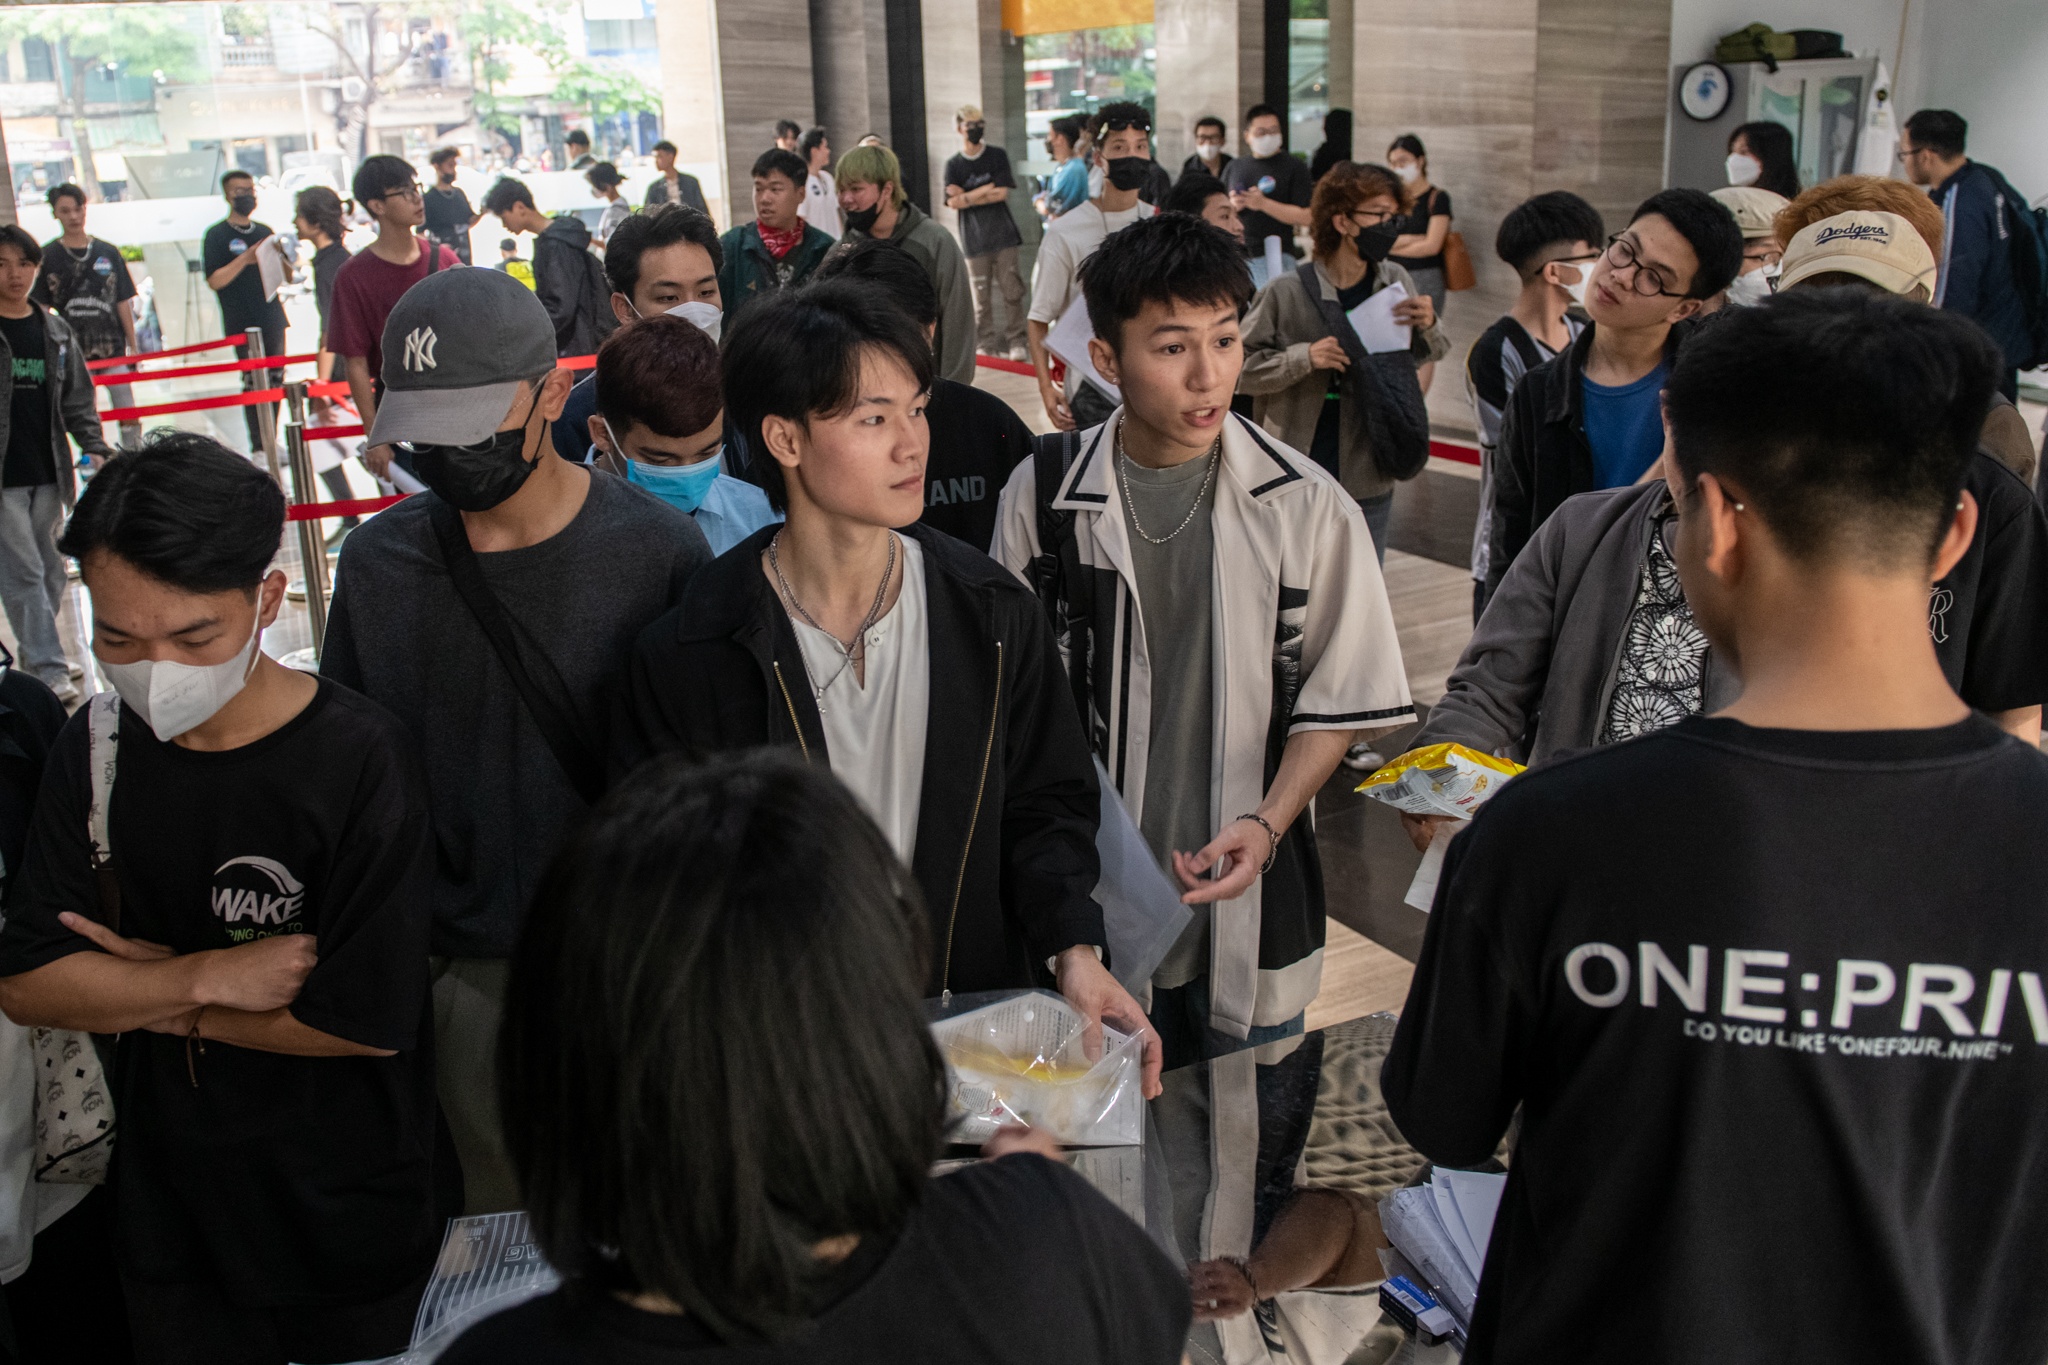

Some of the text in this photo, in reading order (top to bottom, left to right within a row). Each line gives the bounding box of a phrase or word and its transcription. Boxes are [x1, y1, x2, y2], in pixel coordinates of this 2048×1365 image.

[1814, 222, 1888, 246] Dodgers
[402, 325, 438, 372] NY
[924, 475, 986, 507] AND
[211, 886, 305, 925] WAKE
[1683, 1018, 1718, 1041] DO
[1720, 1023, 1772, 1046] YOU
[1774, 1030, 1827, 1054] LIKE
